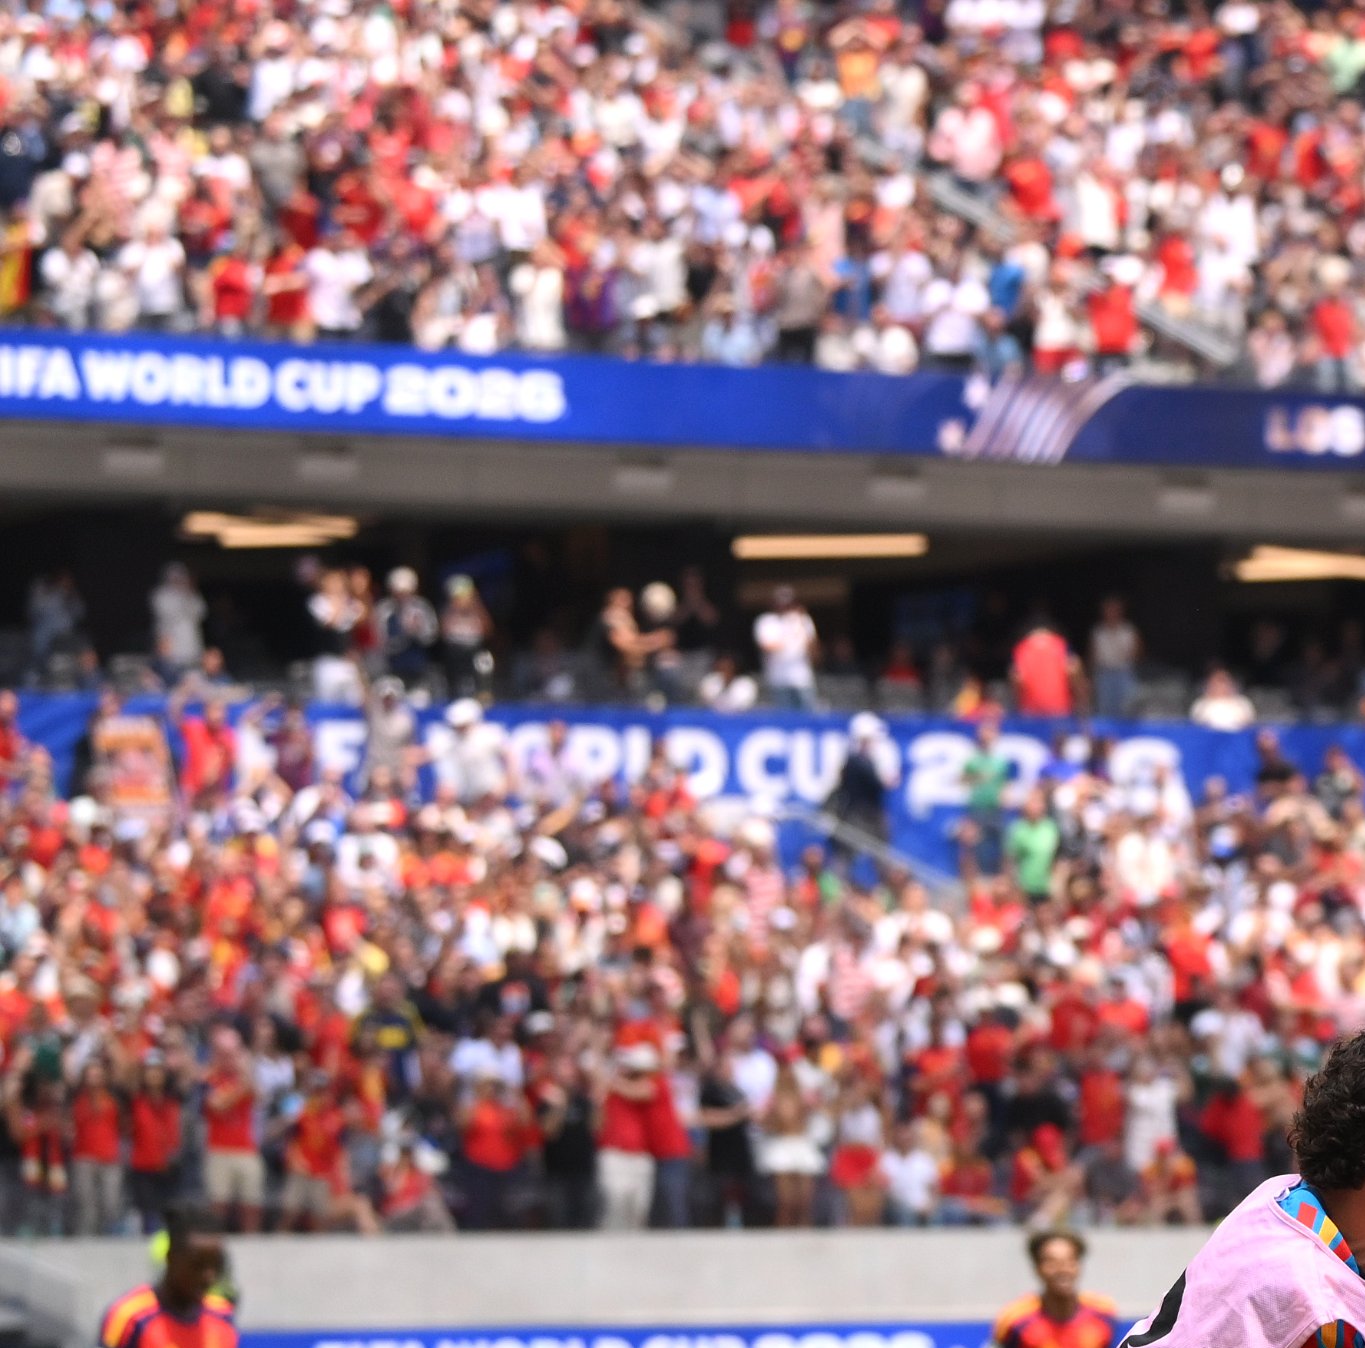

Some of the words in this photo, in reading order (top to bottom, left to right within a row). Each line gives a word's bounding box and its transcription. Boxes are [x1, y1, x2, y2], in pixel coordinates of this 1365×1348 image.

[0, 344, 81, 398] IFA
[81, 349, 272, 411] WORLD
[273, 356, 384, 416] CUP
[382, 362, 568, 424] 2026
